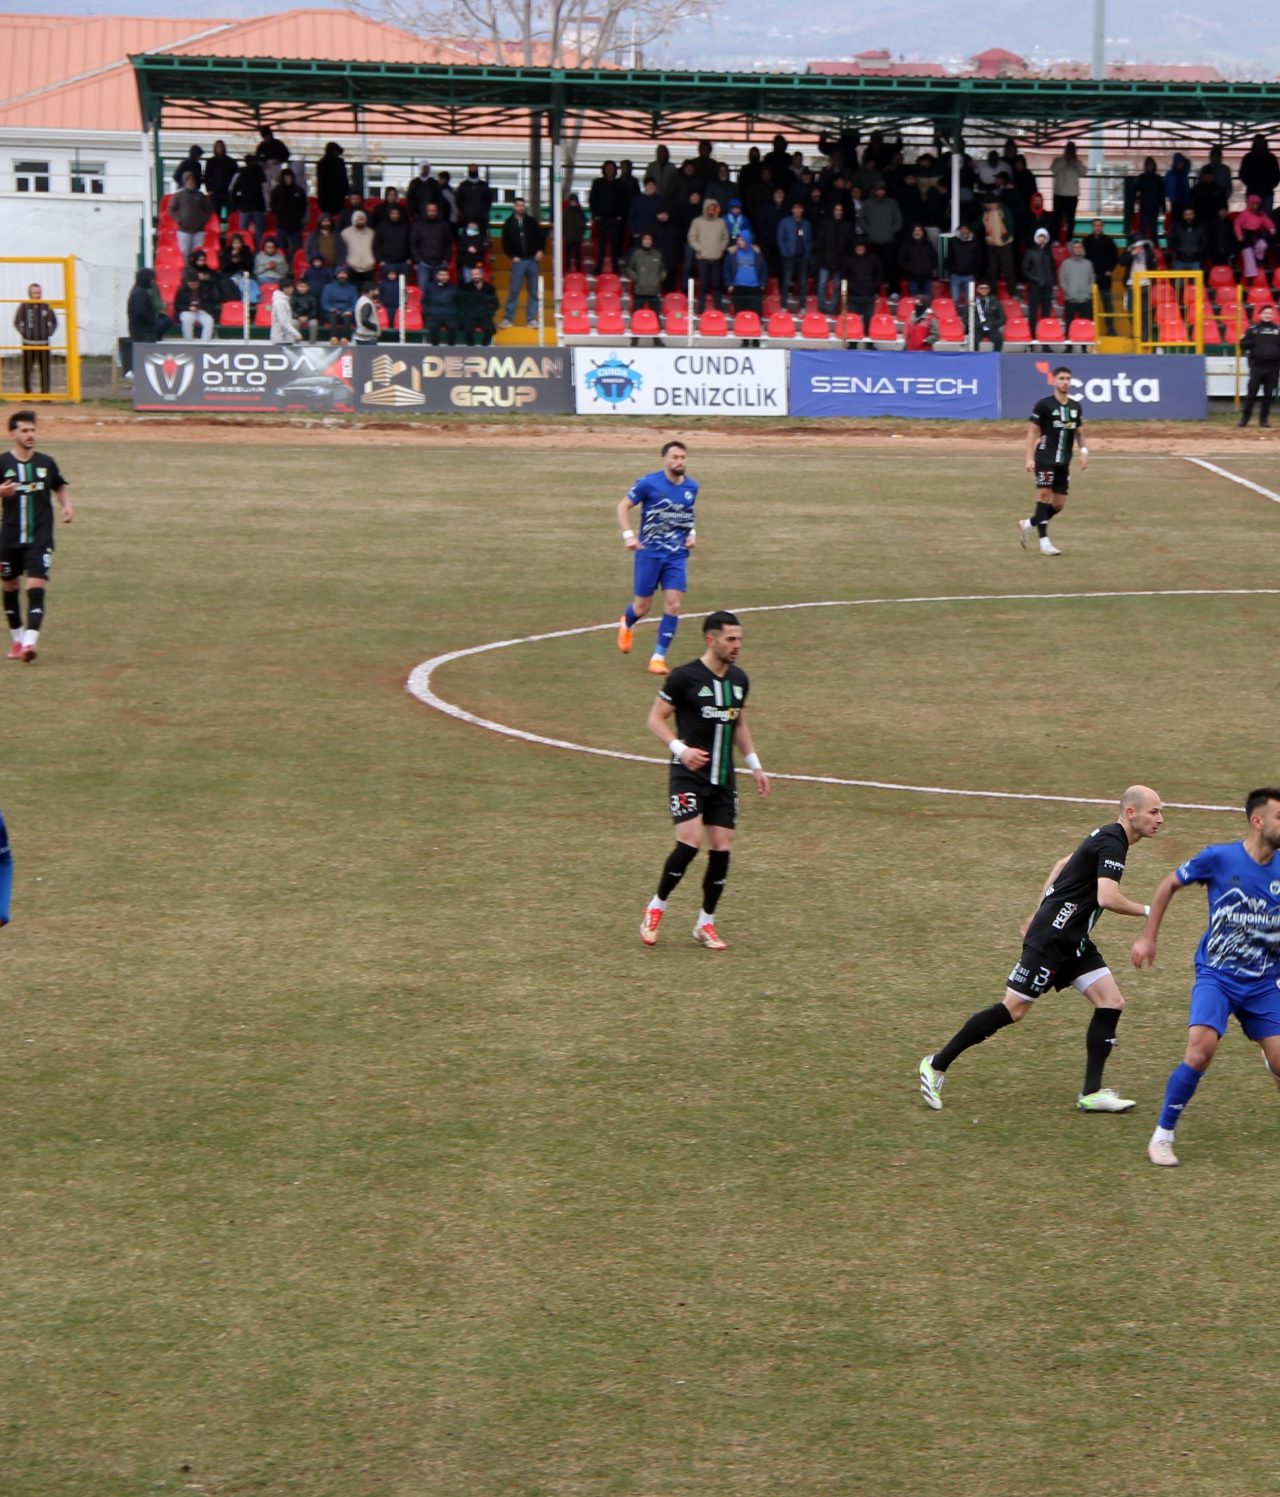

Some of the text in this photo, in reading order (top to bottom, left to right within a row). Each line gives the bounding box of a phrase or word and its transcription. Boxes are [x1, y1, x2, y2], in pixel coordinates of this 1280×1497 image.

[202, 353, 317, 371] MODA
[422, 355, 563, 379] DERMAN
[674, 355, 755, 375] CUNDA
[202, 371, 268, 385] OTO
[811, 376, 978, 395] SENATECH
[450, 385, 537, 407] GRUP
[653, 383, 778, 407] DENİZCİLİK
